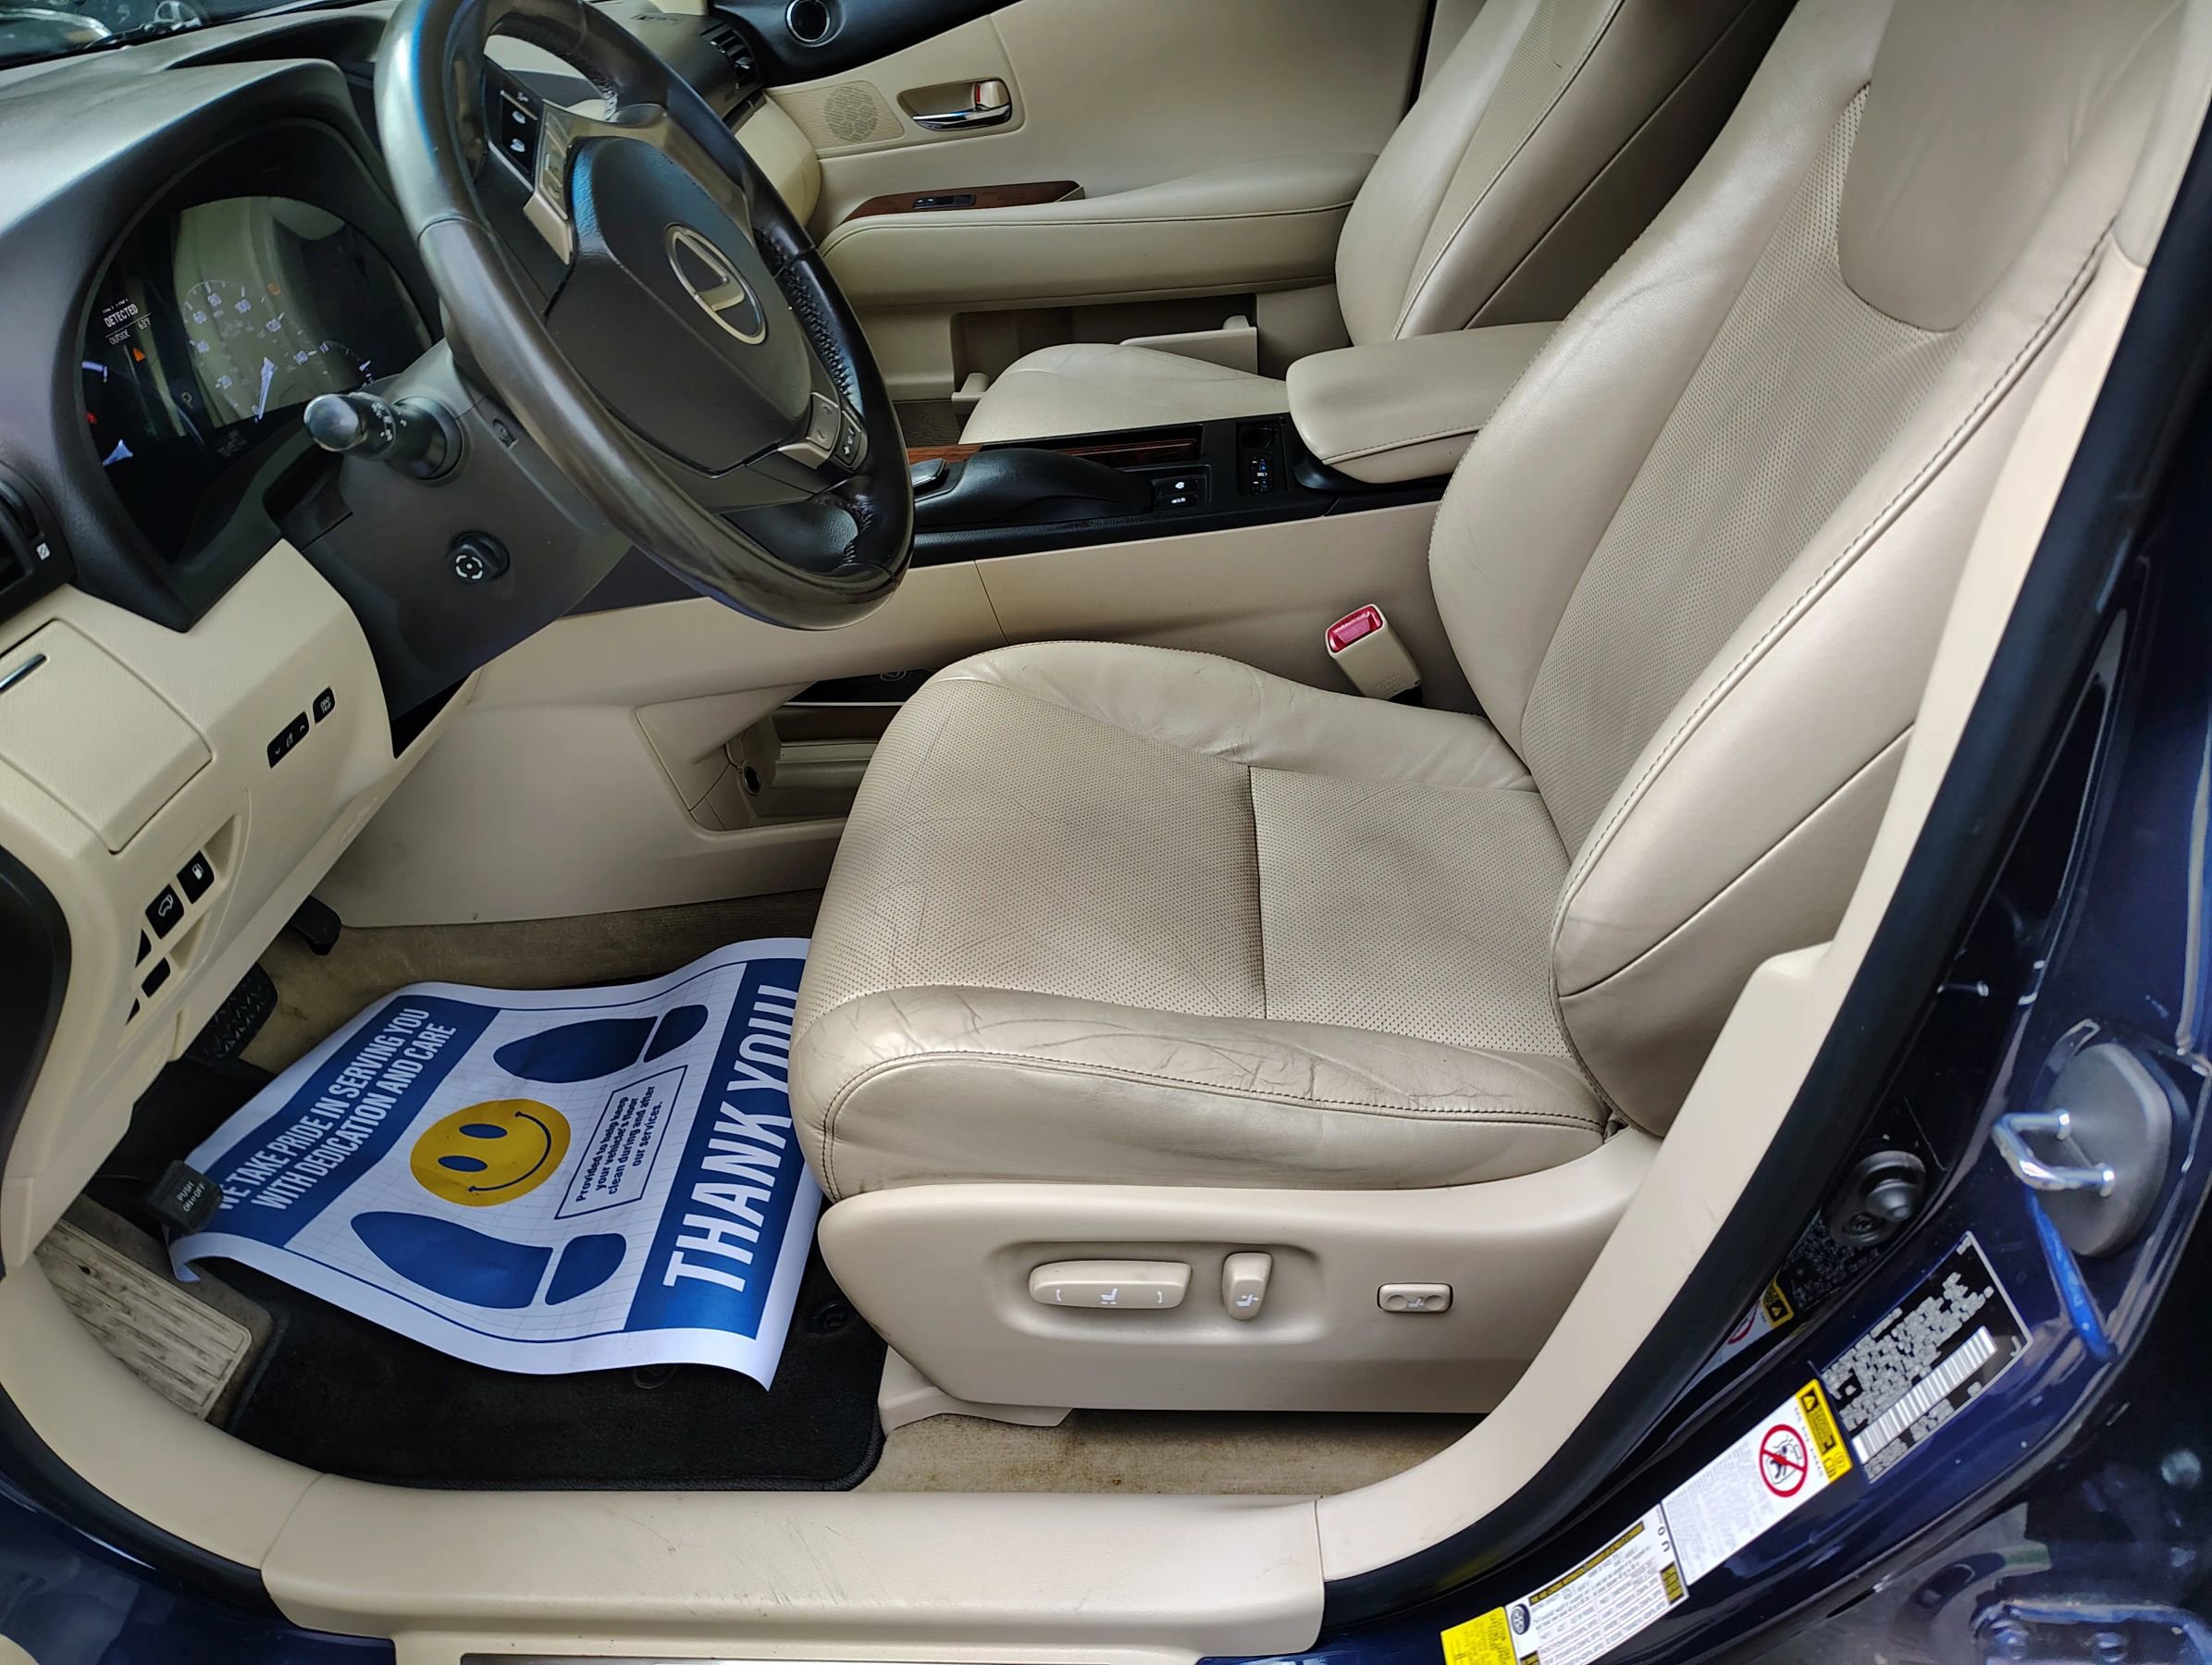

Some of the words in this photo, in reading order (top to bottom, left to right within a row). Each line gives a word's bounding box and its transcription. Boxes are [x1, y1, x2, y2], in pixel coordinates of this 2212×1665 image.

[104, 303, 139, 327] DETECTED
[382, 1007, 430, 1035] YOU
[327, 1034, 406, 1099] SERVING
[250, 1171, 318, 1210] WITH
[293, 1092, 398, 1178] DEDICATION
[375, 1058, 425, 1095] AND
[403, 1022, 458, 1061] CARE
[310, 1096, 351, 1119] IN
[610, 1096, 629, 1122] keep
[638, 1101, 663, 1148] services.
[266, 1115, 334, 1157] PRIDE
[595, 1166, 611, 1191] your
[604, 1121, 630, 1166] vehicle's
[621, 1097, 639, 1121] floor
[595, 1143, 609, 1155] to
[599, 1121, 620, 1144] help
[608, 1165, 626, 1195] clean
[617, 1128, 641, 1164] during
[632, 1109, 647, 1128] and
[640, 1086, 656, 1109] after
[225, 1150, 290, 1186] TAKE
[632, 1149, 646, 1167] our
[177, 1180, 195, 1202] PUSH
[575, 1154, 603, 1202] Provided
[662, 1101, 793, 1292] THANK
